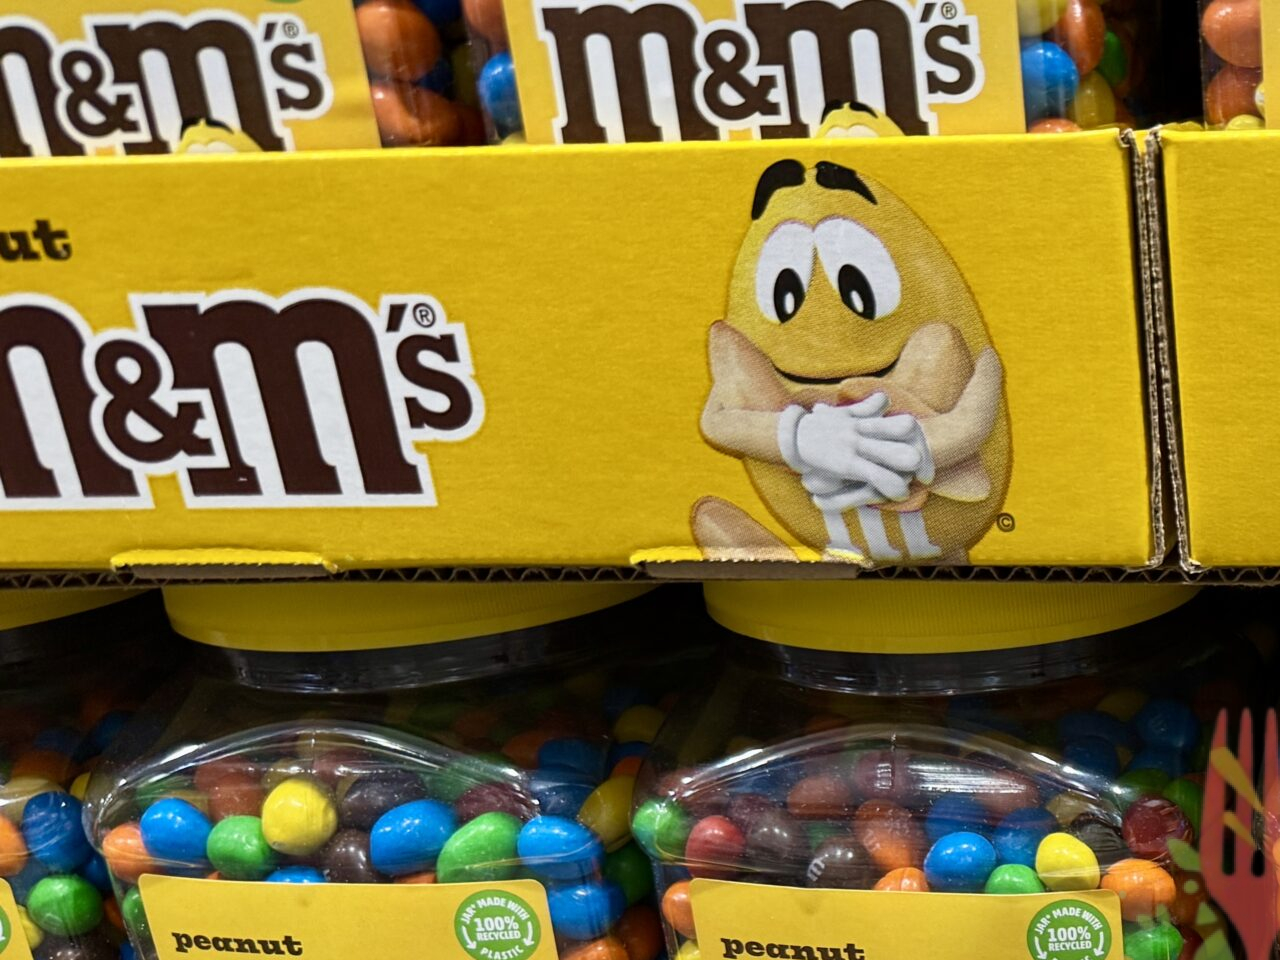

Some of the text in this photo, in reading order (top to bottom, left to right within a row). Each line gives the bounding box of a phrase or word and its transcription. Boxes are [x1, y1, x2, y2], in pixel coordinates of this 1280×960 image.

[540, 0, 975, 143] m&m's
[477, 896, 506, 909] MADE
[506, 900, 530, 921] WITH
[474, 916, 519, 933] 100%
[1051, 906, 1082, 920] MADE
[1081, 910, 1103, 931] WITH
[476, 930, 521, 942] RECYCLED
[1047, 926, 1091, 943] 100%
[172, 932, 303, 956] peanut
[480, 945, 524, 960] PLASTIC
[1047, 940, 1093, 952] RECYCLED
